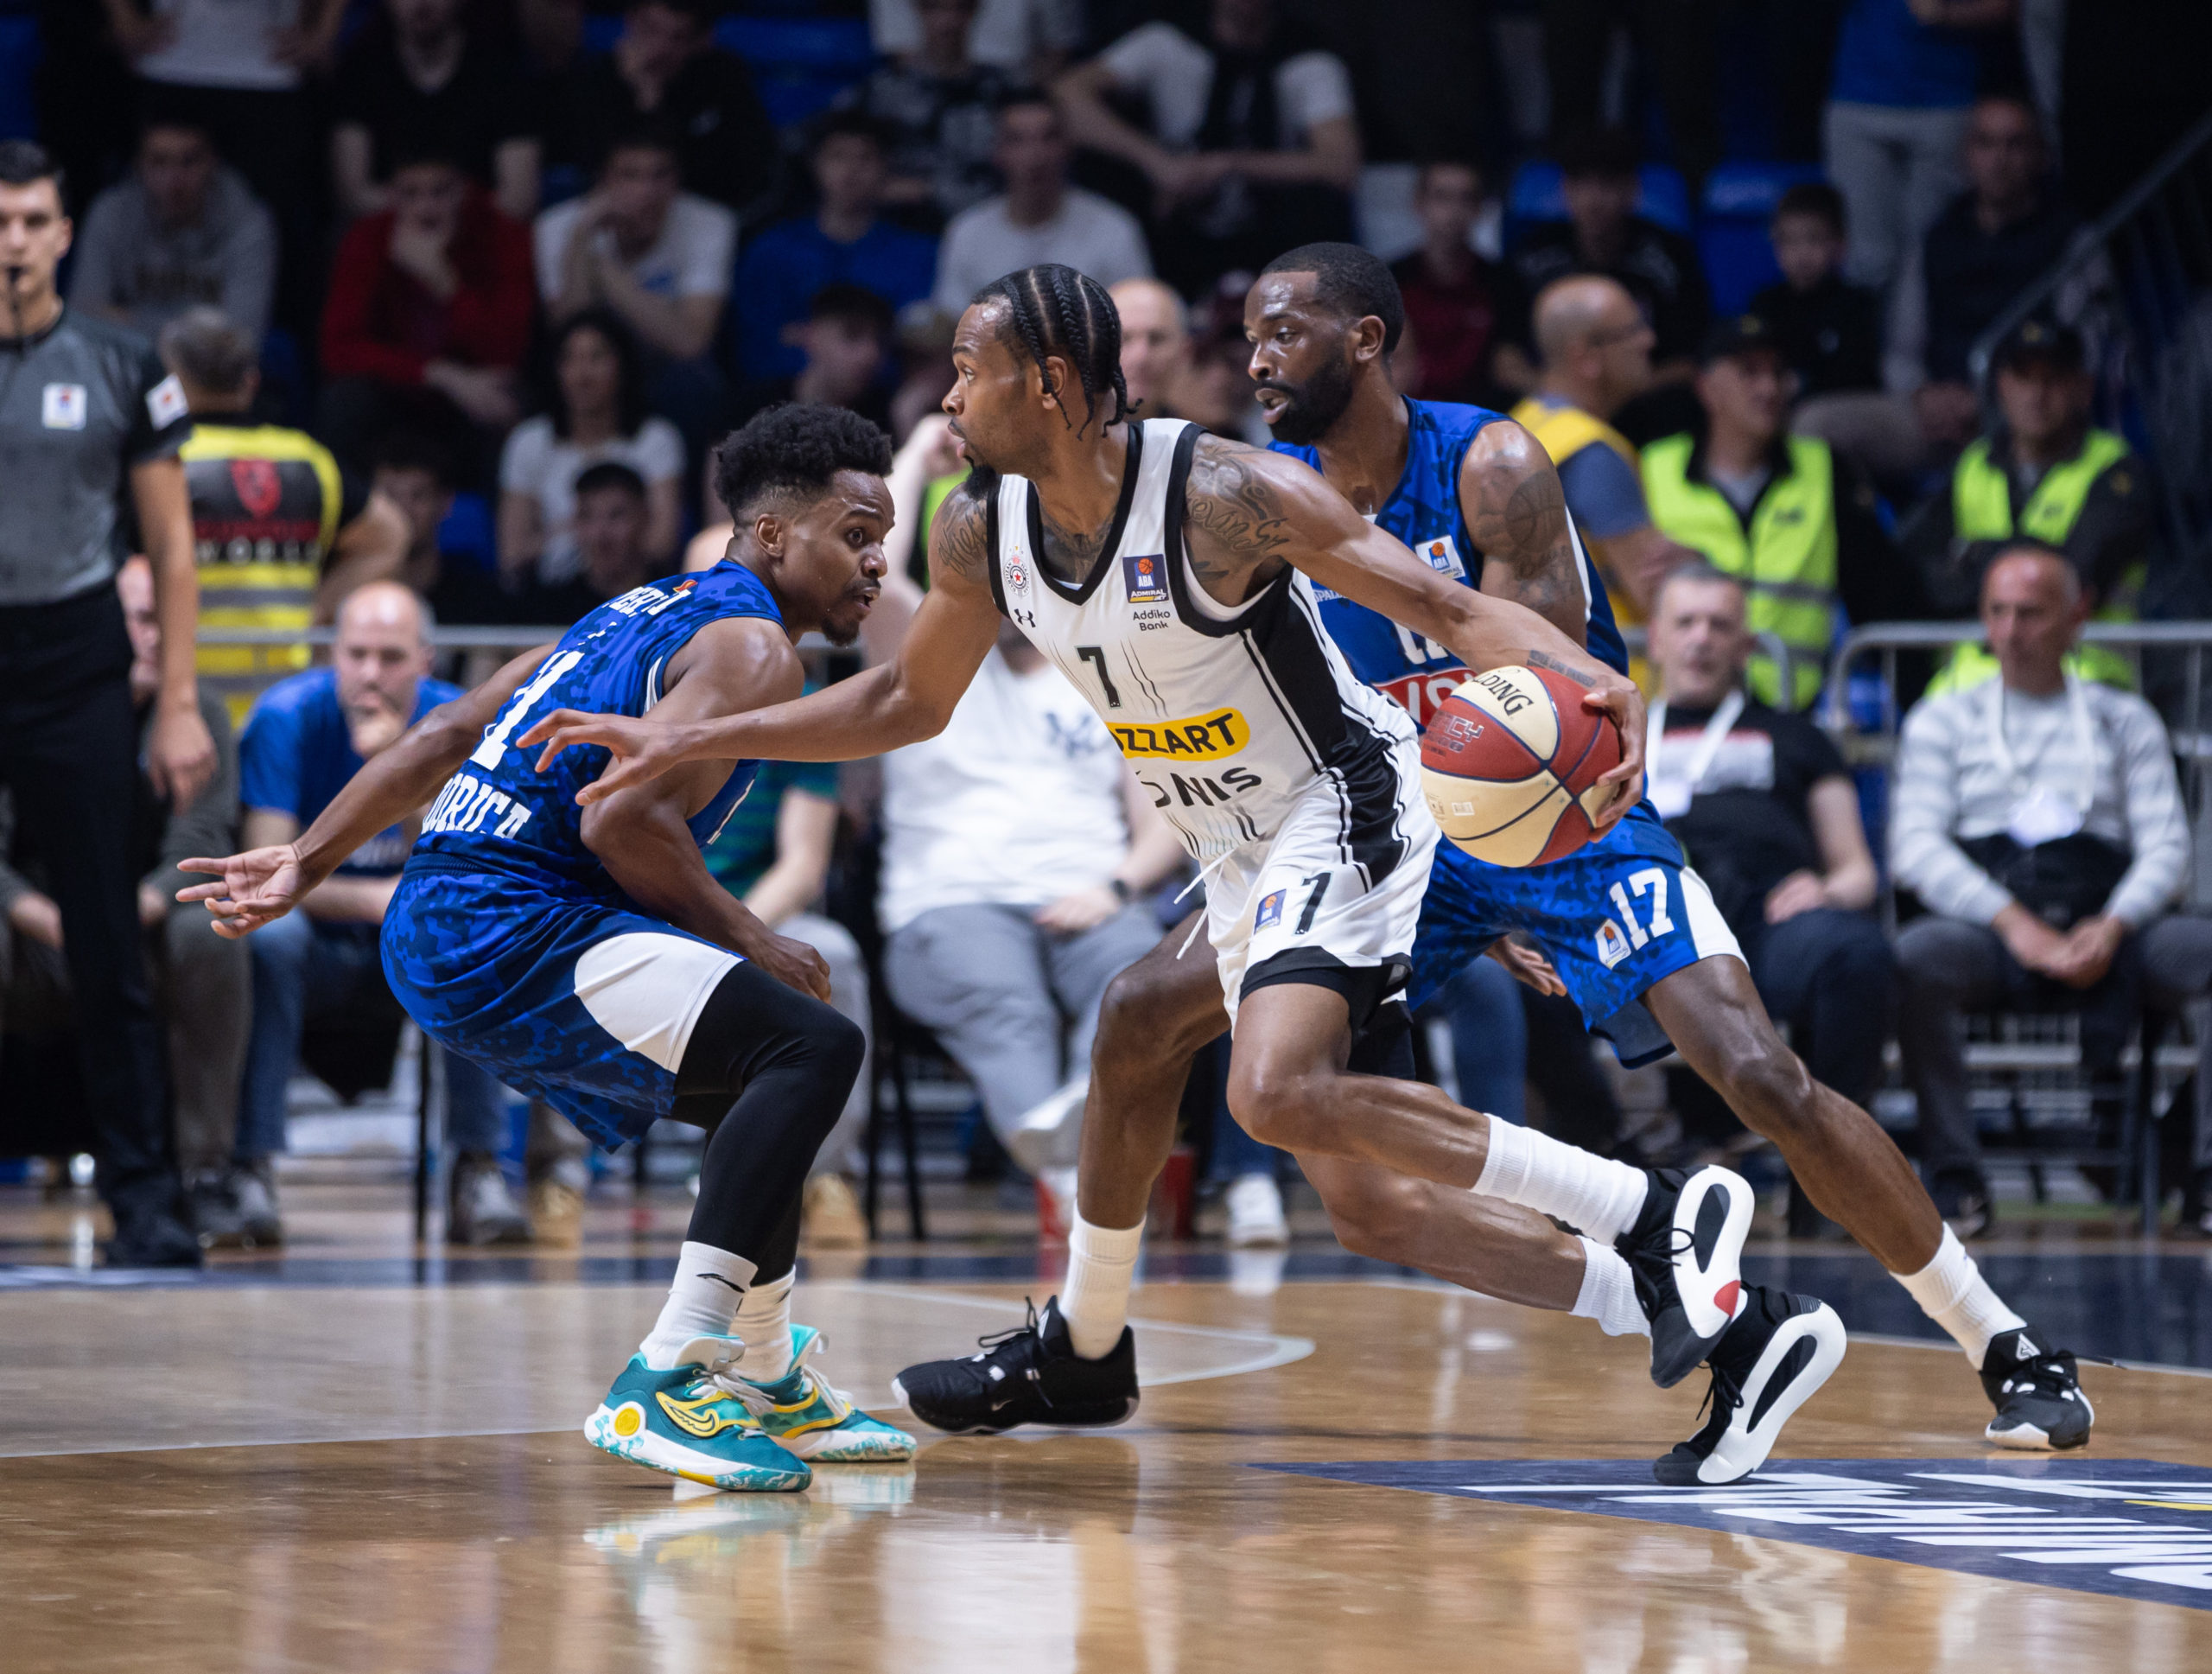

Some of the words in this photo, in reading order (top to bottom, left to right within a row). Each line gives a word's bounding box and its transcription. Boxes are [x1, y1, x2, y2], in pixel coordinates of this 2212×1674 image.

[1138, 575, 1154, 588] ABA
[1131, 589, 1166, 598] ADMIRAL
[1133, 609, 1170, 621] Addiko
[1139, 621, 1168, 631] Bank
[1076, 646, 1121, 709] 7
[1293, 871, 1332, 936] 7
[1609, 867, 1675, 951] 17
